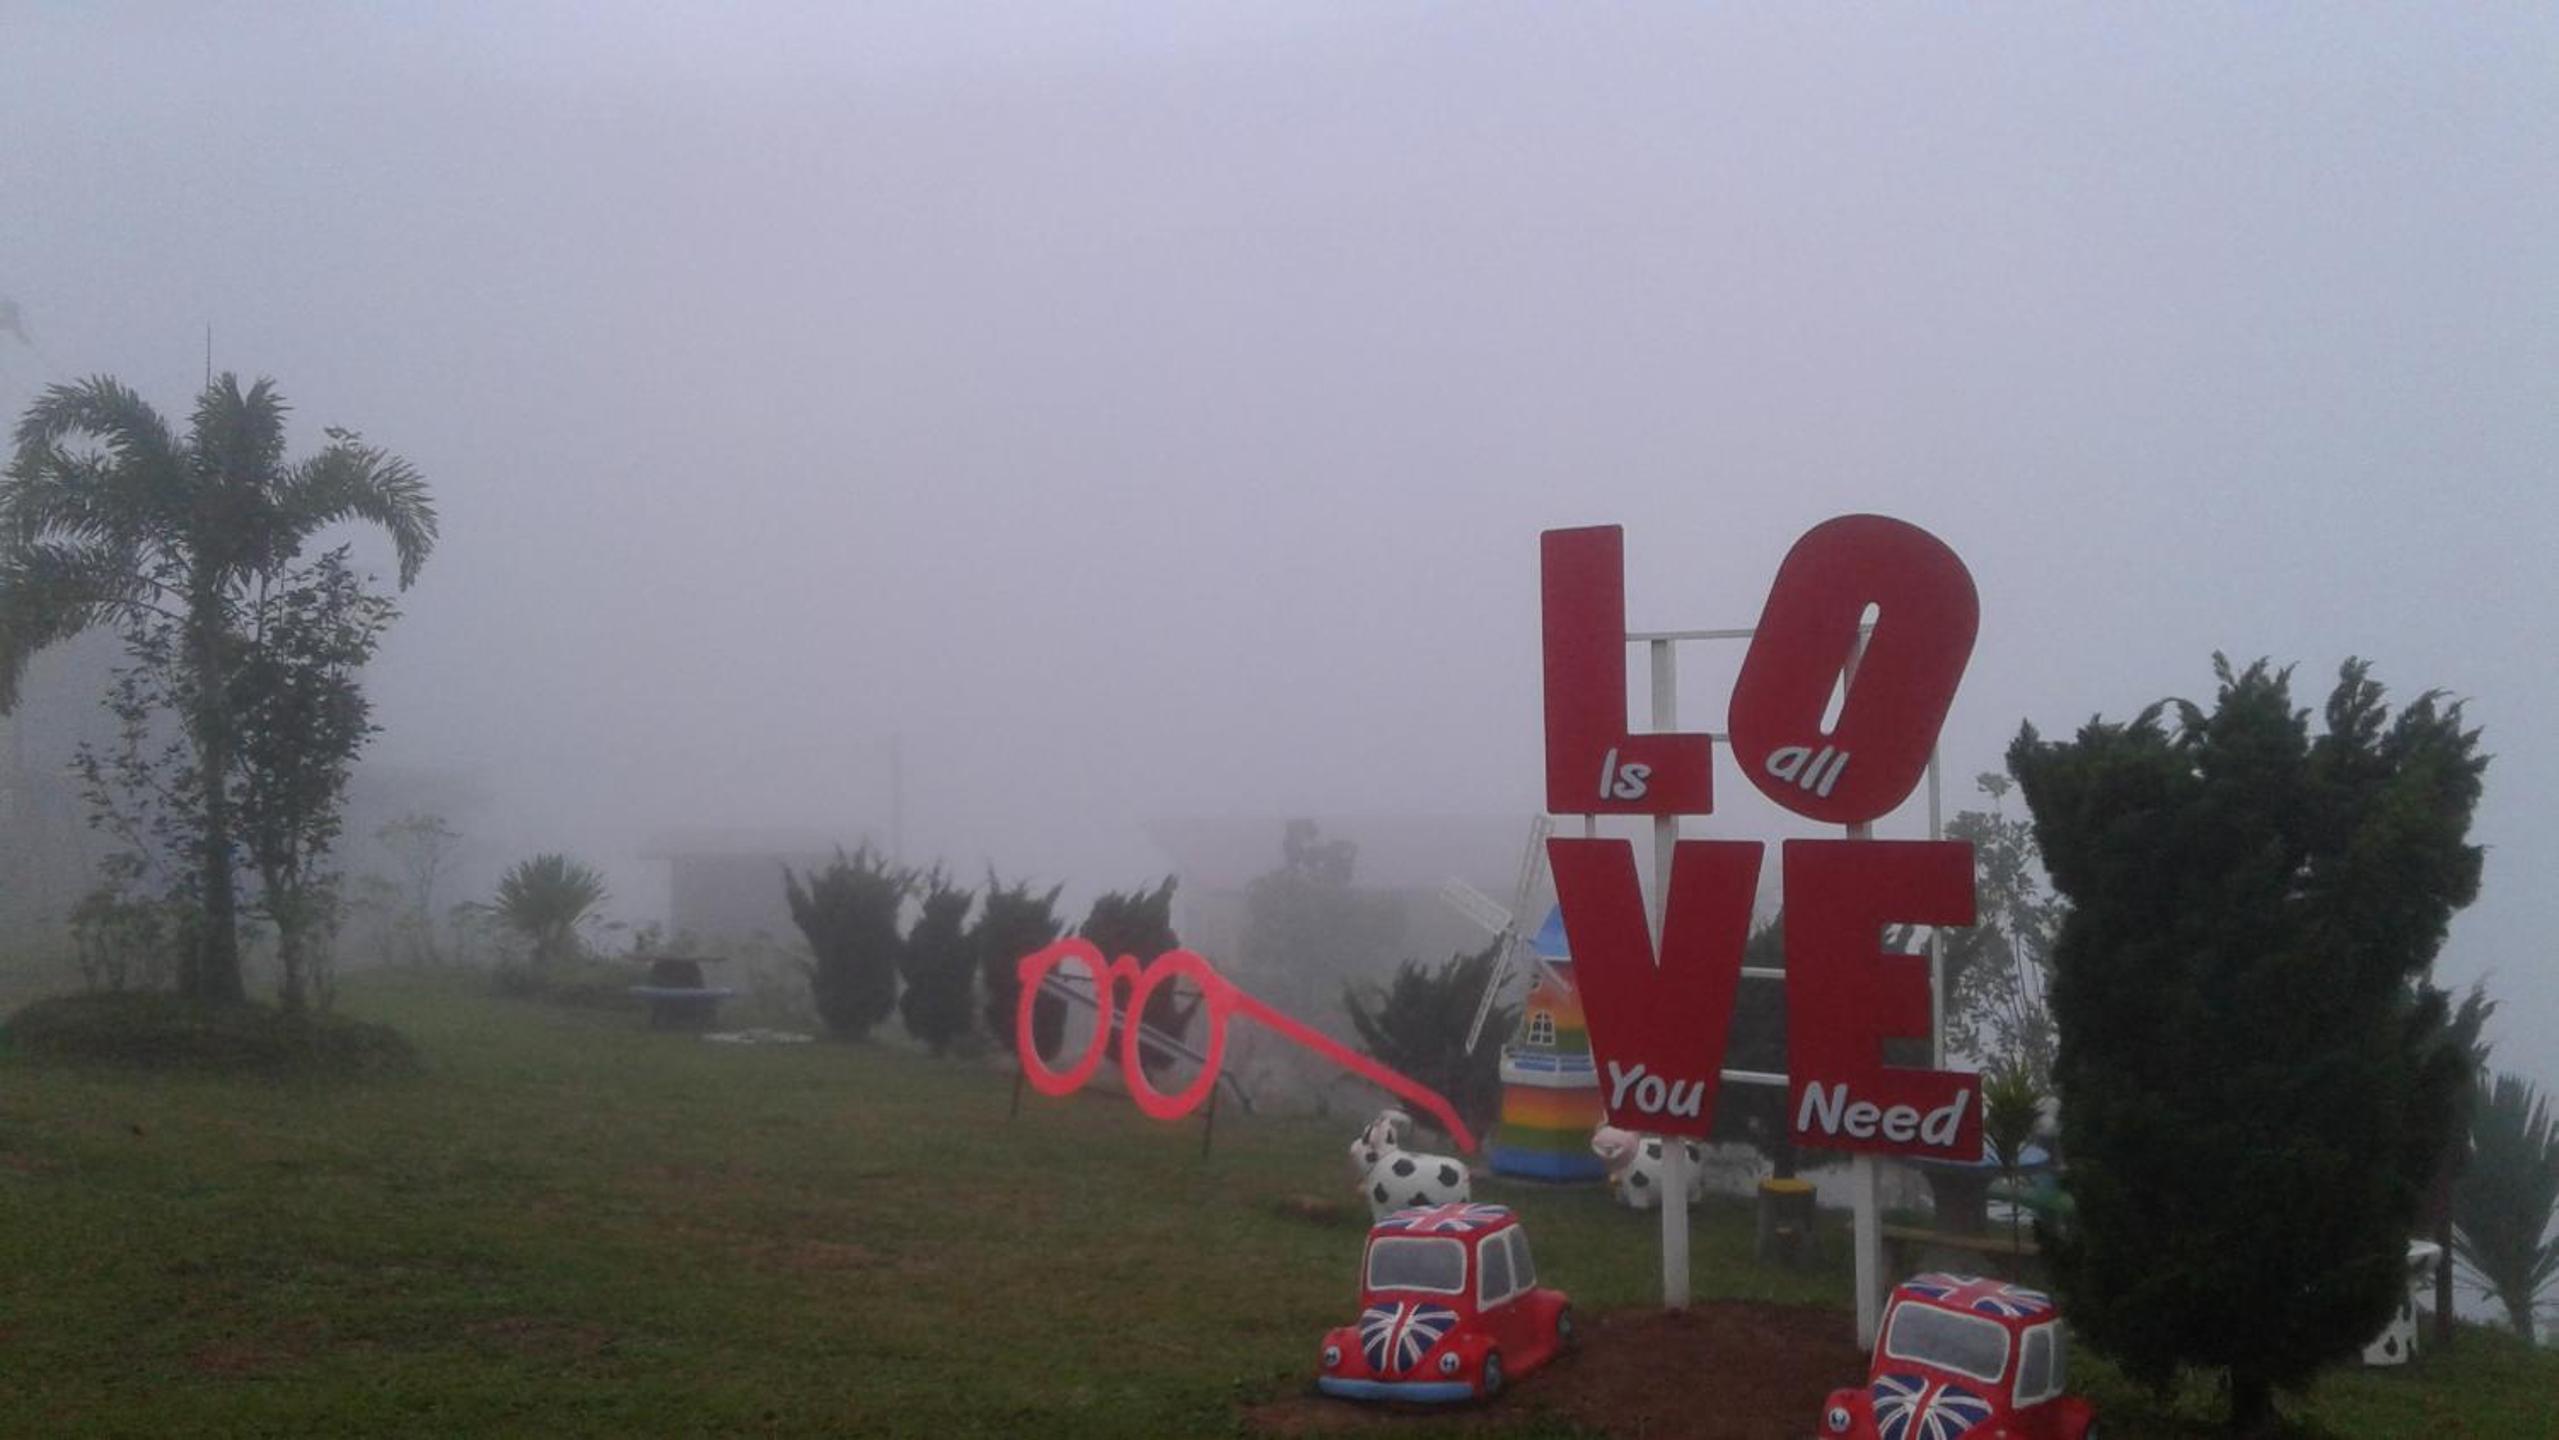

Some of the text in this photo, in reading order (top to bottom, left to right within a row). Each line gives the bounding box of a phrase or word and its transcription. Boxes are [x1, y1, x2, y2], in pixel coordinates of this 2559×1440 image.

[1600, 745, 1850, 800] Is all
[1607, 1060, 1970, 1148] You Need
